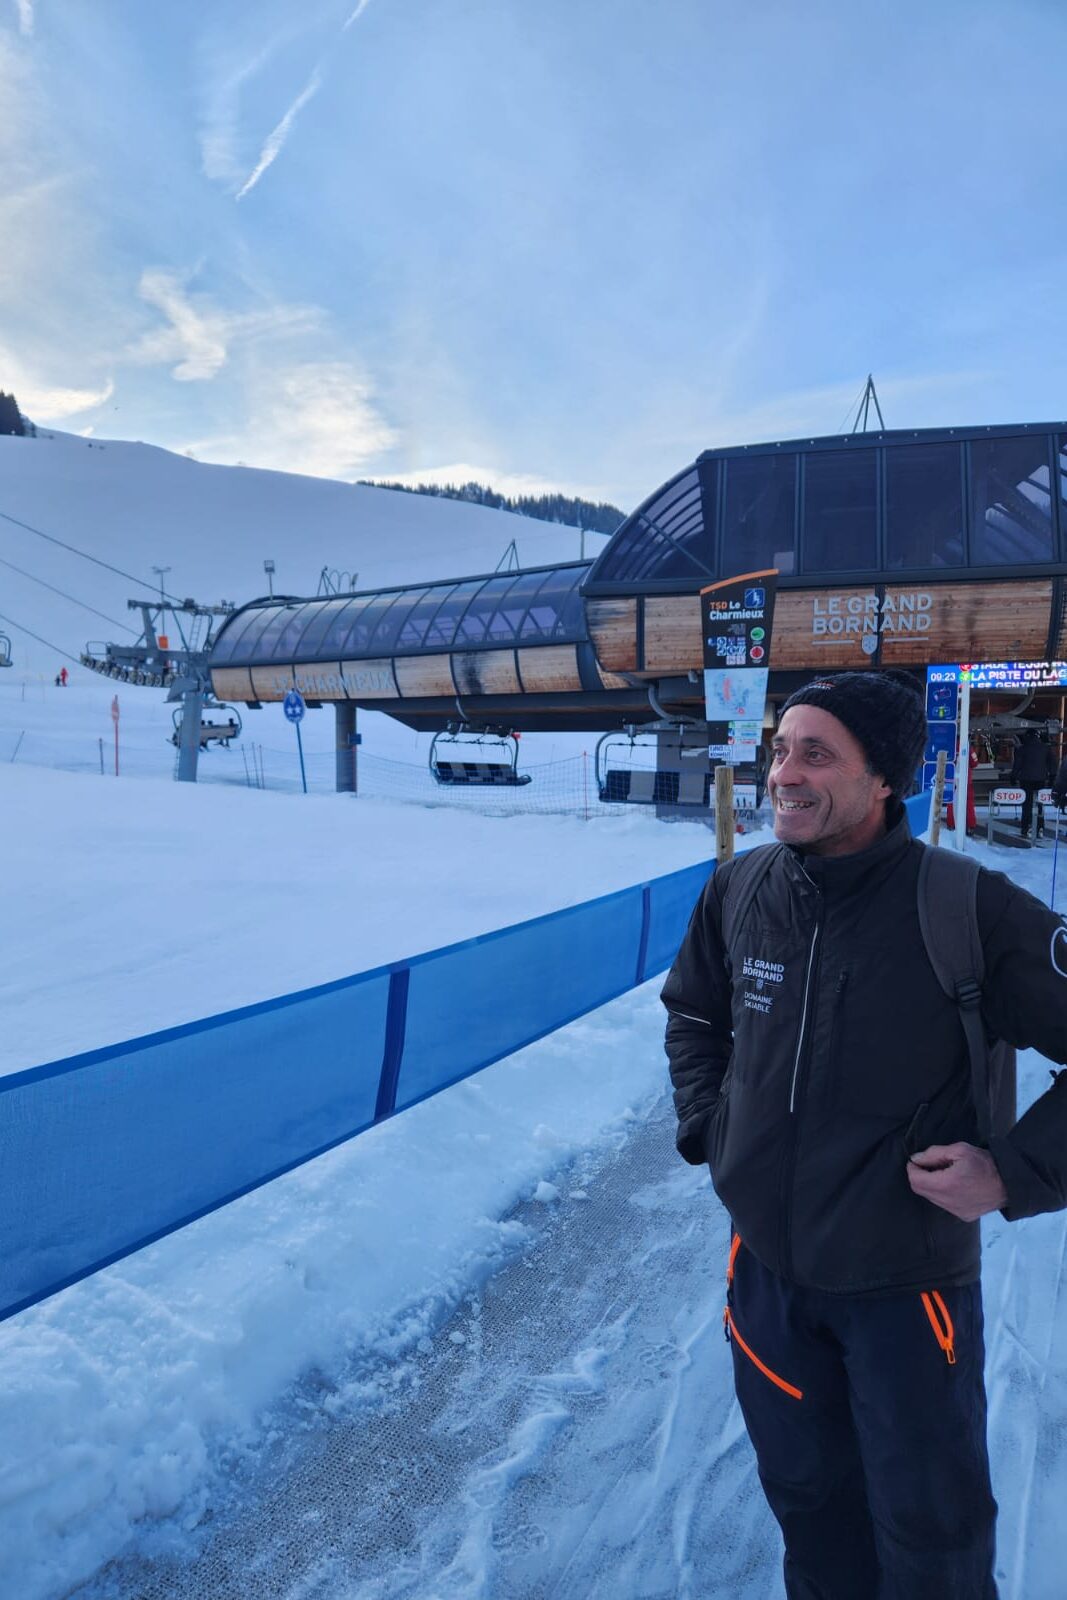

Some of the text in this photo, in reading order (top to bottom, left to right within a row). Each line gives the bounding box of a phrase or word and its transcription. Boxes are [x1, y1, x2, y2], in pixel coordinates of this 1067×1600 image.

[710, 601, 741, 610] TSD Le
[813, 592, 933, 615] LE GRAND
[709, 608, 764, 620] Charmieux
[813, 613, 932, 636] BORNAND
[930, 672, 956, 681] 09:23
[971, 671, 986, 682] LA
[989, 670, 1021, 681] PISTE
[1023, 670, 1040, 680] DU
[996, 792, 1022, 801] STOP
[743, 956, 785, 973] LE GRAND
[742, 965, 784, 983] BORNAND
[744, 991, 774, 1006] DOMAINE
[744, 999, 770, 1014] SKIABLE
